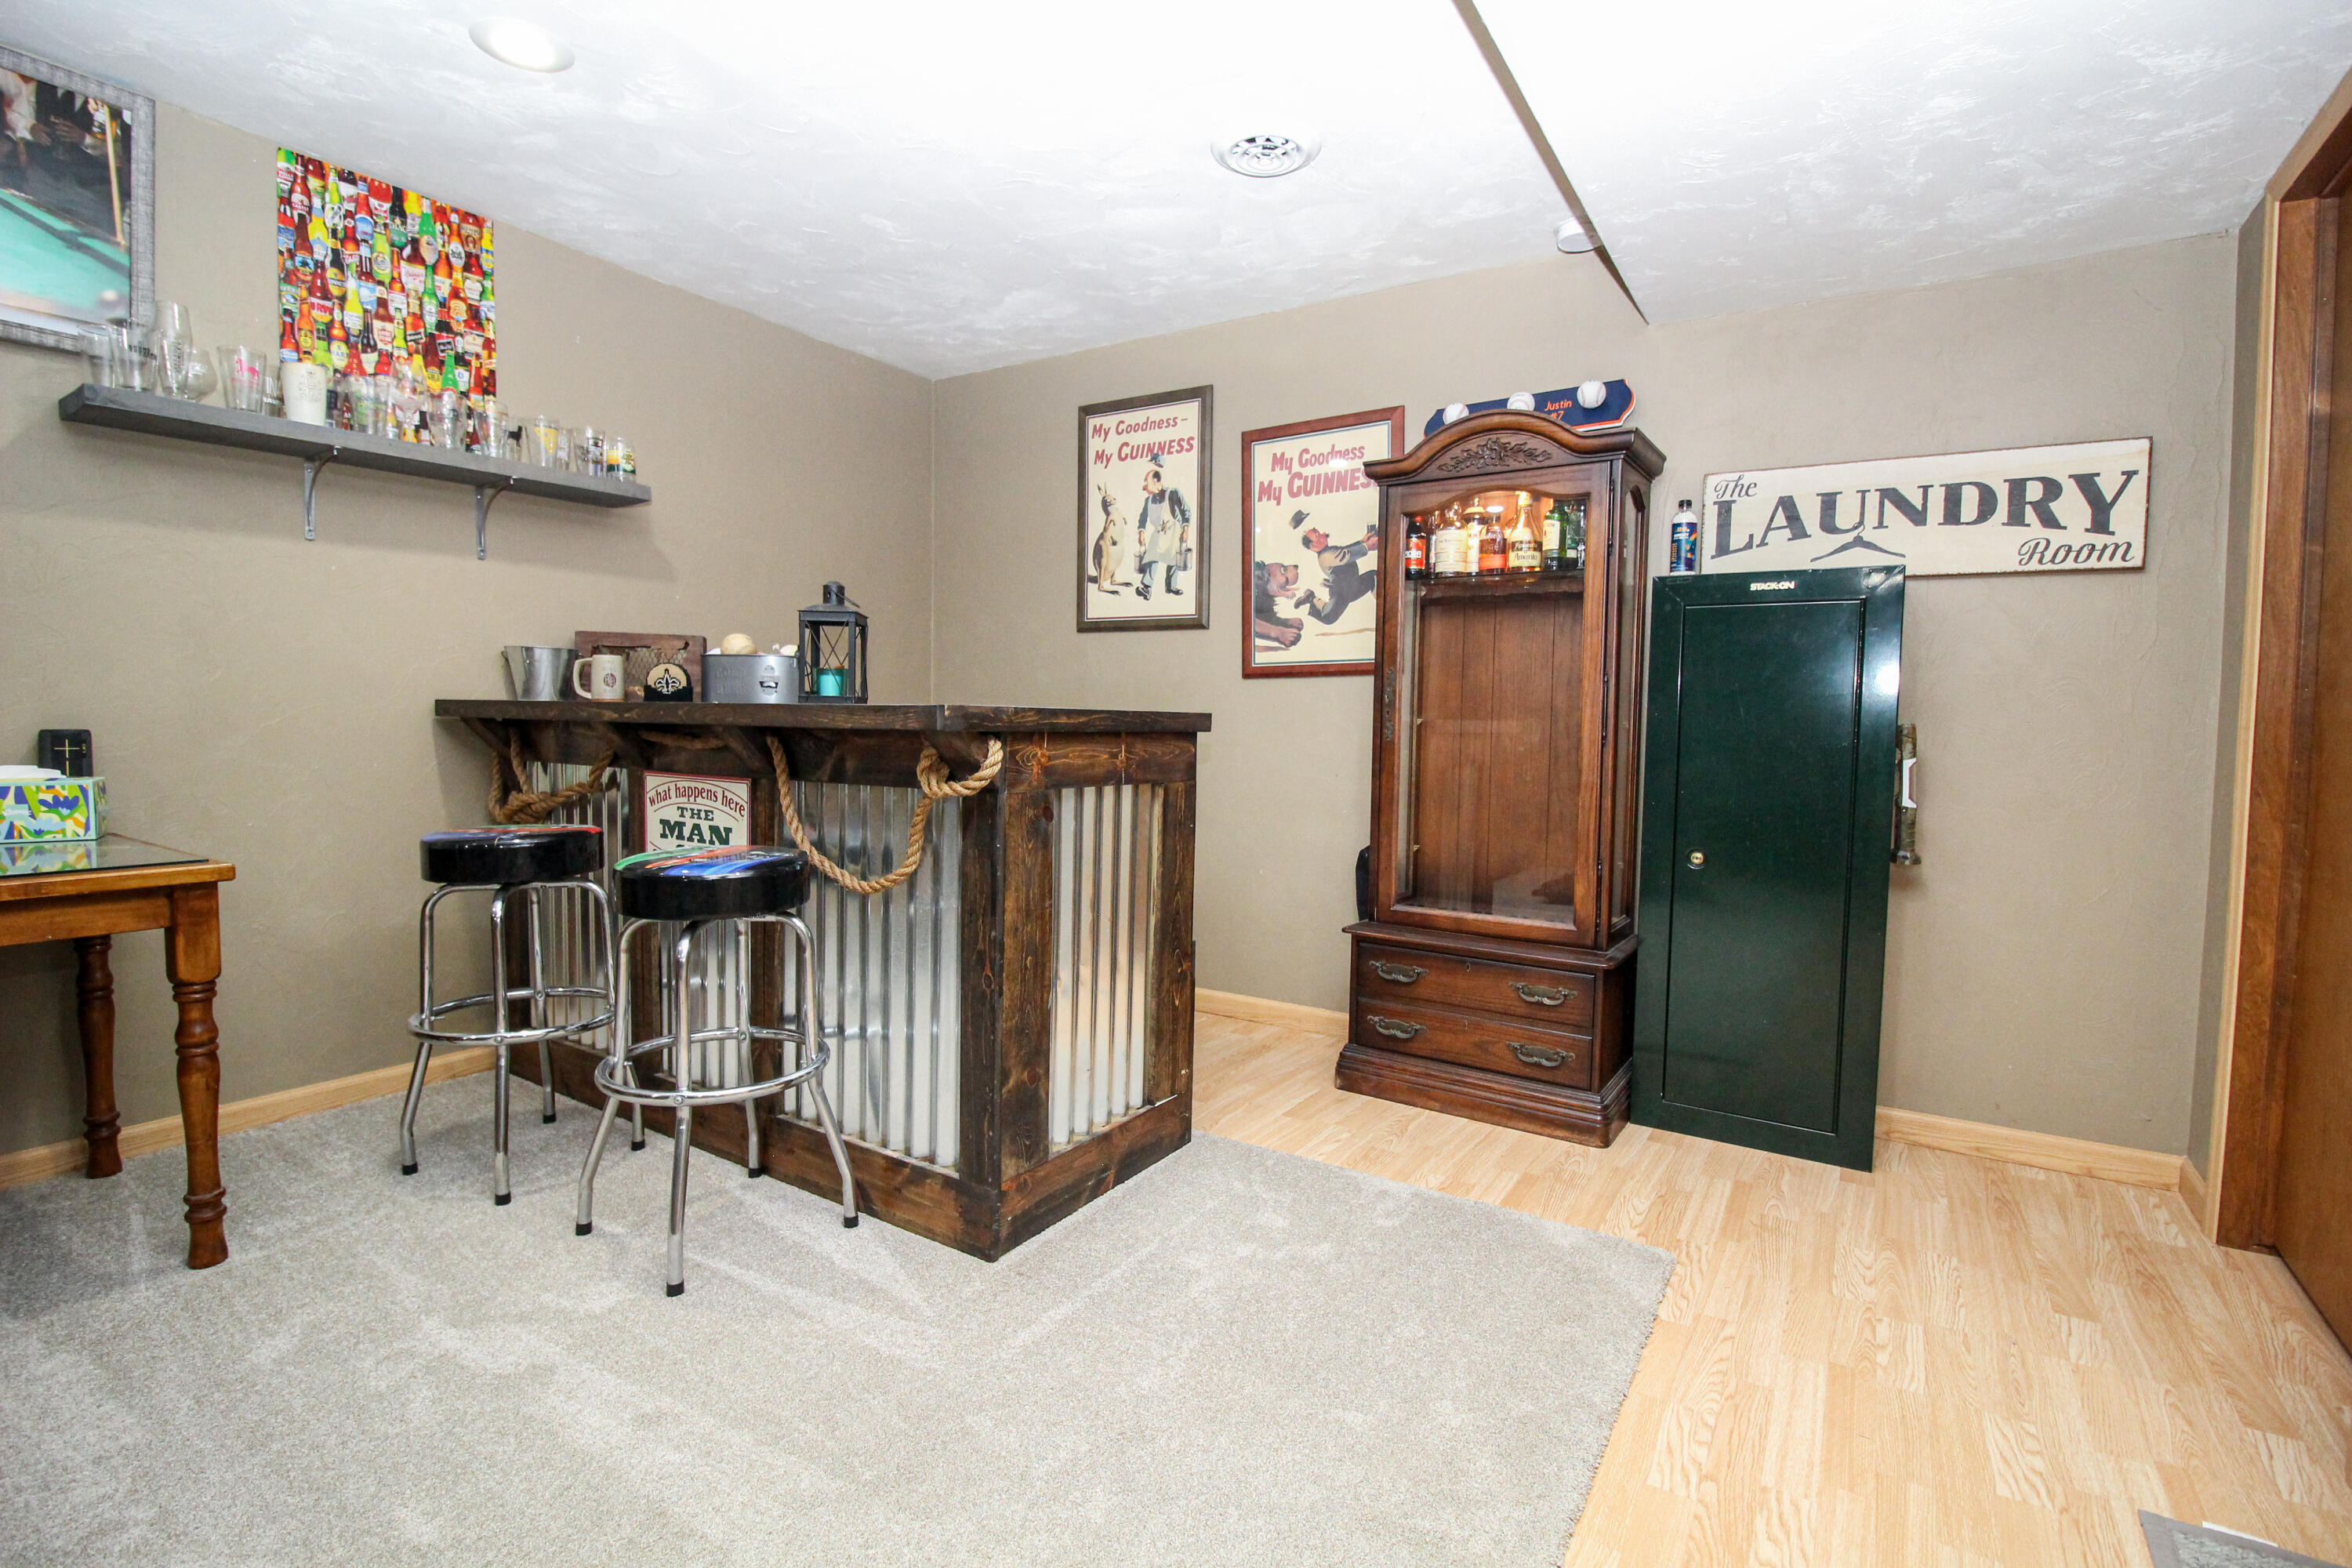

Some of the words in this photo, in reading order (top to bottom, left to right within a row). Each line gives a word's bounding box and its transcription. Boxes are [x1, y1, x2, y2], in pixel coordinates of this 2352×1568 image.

[1544, 398, 1573, 412] Justin
[1091, 423, 1111, 443] My
[1094, 448, 1113, 470] My
[1117, 436, 1195, 462] GUINNESS
[1271, 452, 1294, 475] My
[1298, 444, 1365, 469] Goodness
[1258, 480, 1282, 506] My
[1714, 474, 1758, 499] The
[1710, 470, 2140, 560] LAUNDRY
[2018, 537, 2135, 566] Room
[1749, 580, 1795, 591] STACK-ON
[648, 785, 672, 808] what
[675, 782, 718, 803] happens
[721, 789, 746, 818] here
[677, 806, 715, 822] THE
[659, 818, 733, 846] MAN
